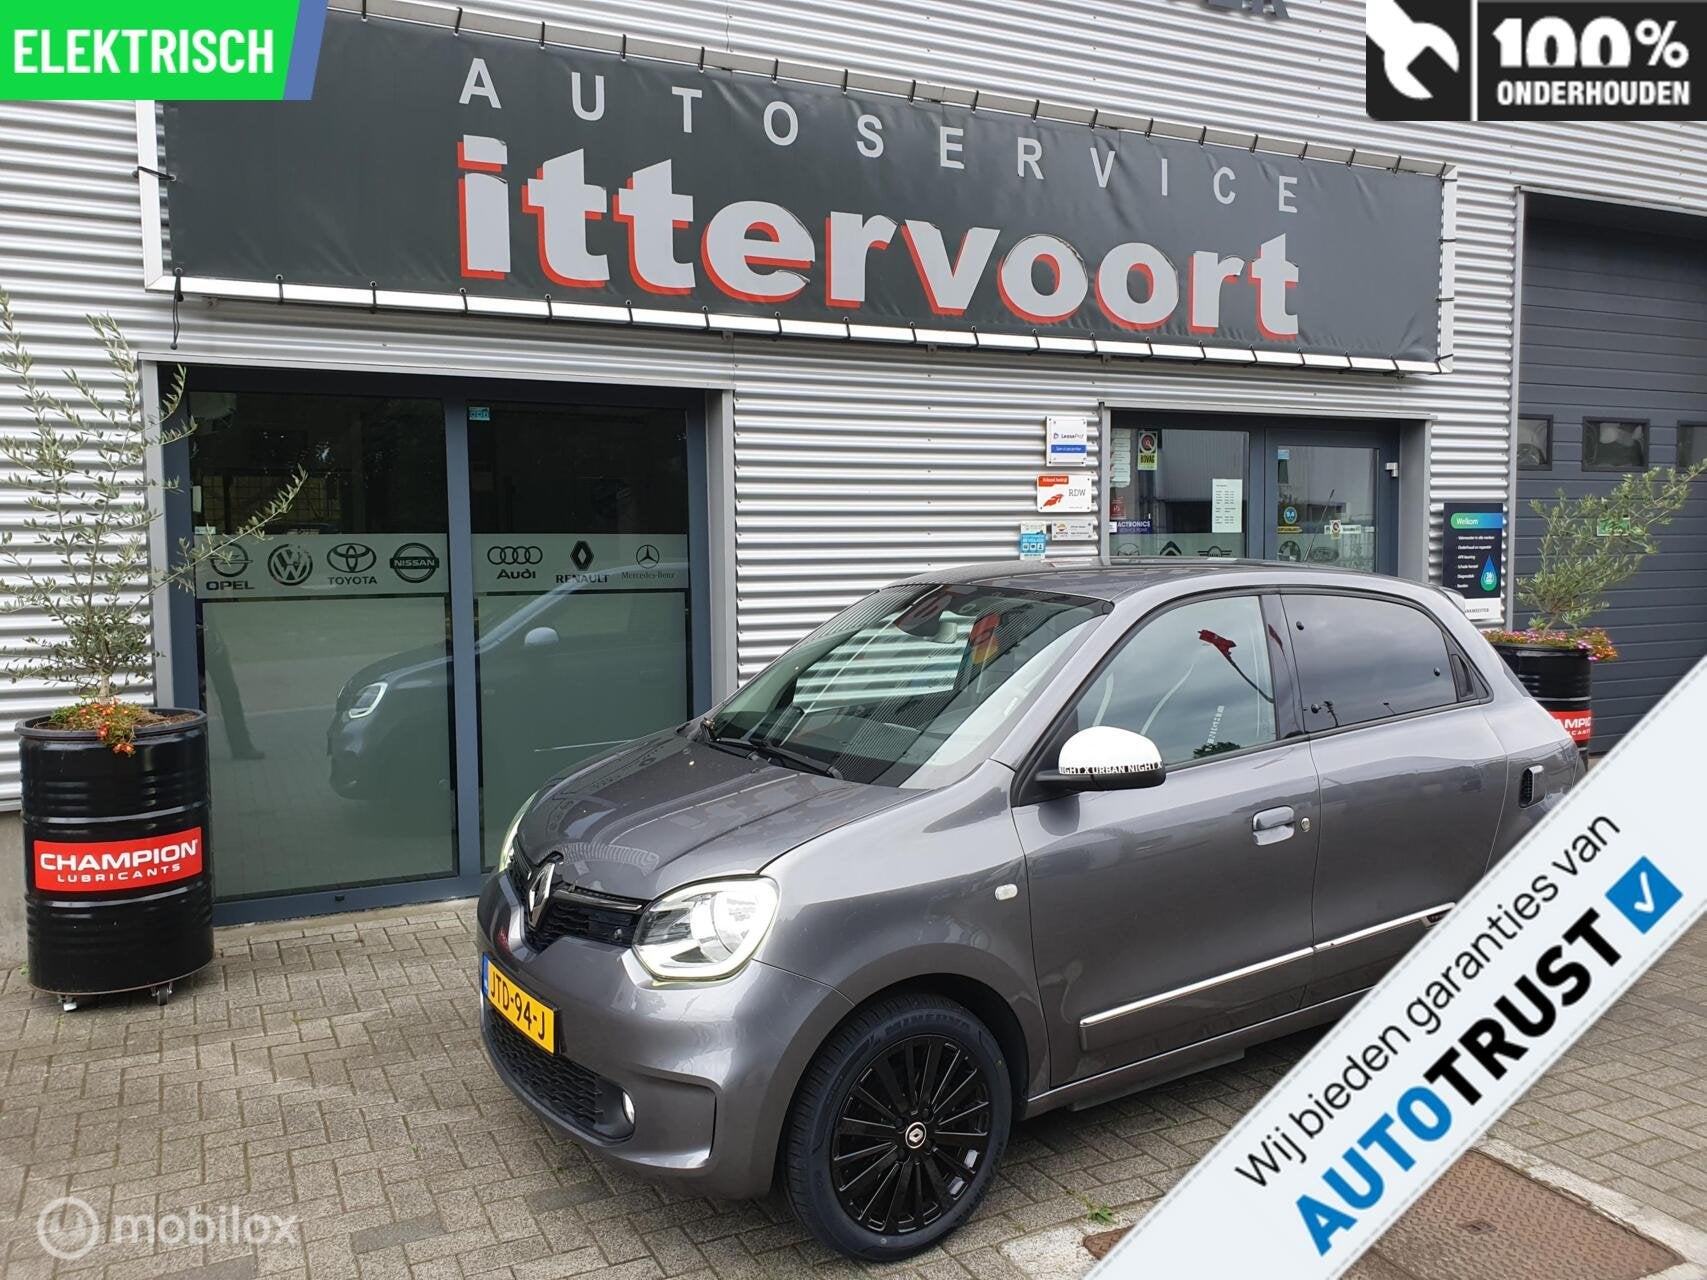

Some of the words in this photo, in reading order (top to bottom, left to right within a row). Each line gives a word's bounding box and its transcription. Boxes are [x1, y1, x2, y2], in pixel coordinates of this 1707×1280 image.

[457, 134, 1299, 340] ittervoort
[1068, 488, 1086, 497] RDW
[1456, 517, 1479, 525] Welkom
[393, 559, 435, 567] NISSAN
[496, 568, 537, 580] Audi
[555, 574, 610, 584] RENAULT
[621, 571, 676, 580] Mercedes-Benz
[328, 576, 377, 585] TOYOTA
[205, 581, 255, 591] OPEL
[1093, 765, 1125, 775] URBAN
[1128, 763, 1156, 773] NIGHT
[40, 840, 196, 871] CHAMPION
[57, 863, 181, 883] LUBRICANTS
[491, 971, 545, 1040] JTD-94-J
